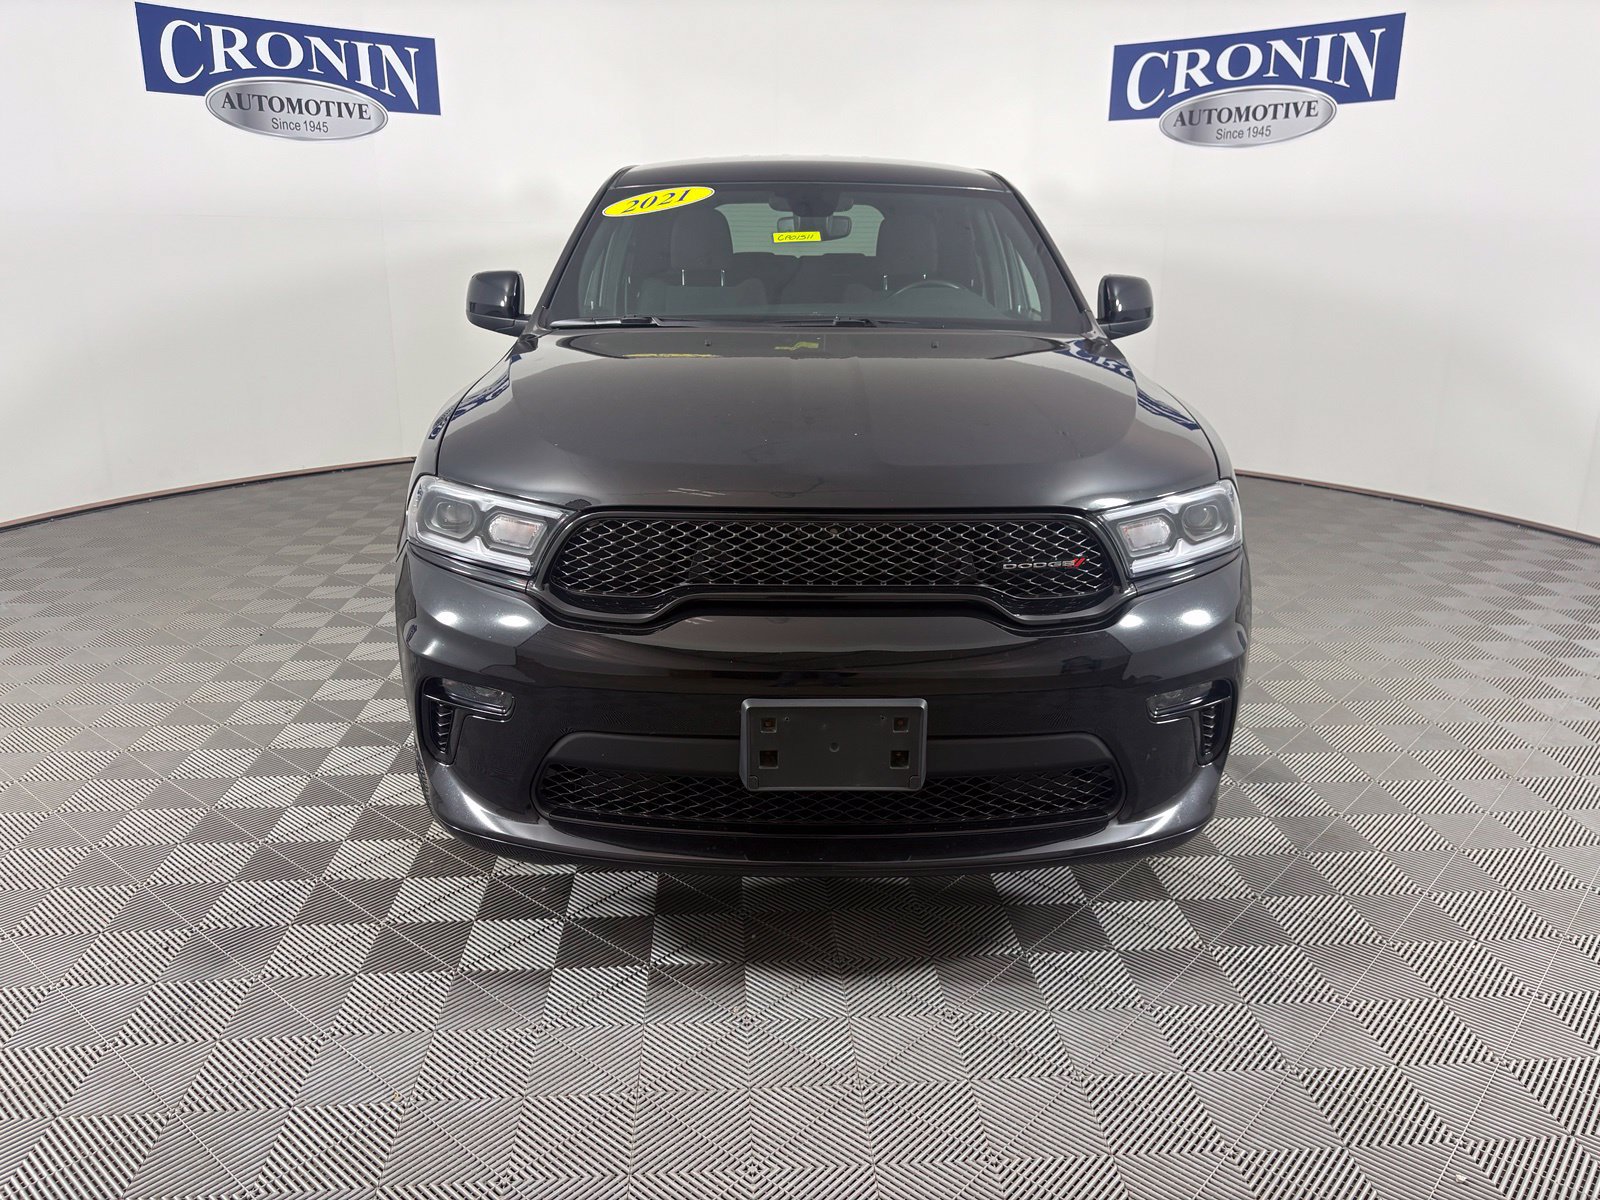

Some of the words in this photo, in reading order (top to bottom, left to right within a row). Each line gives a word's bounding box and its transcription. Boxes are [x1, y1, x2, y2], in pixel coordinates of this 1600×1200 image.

[160, 19, 420, 110] CRONIN
[1126, 28, 1386, 111] CRONIN
[221, 92, 372, 121] AUTOMOTIVE
[1173, 100, 1319, 127] AUTOMOTIVE
[271, 118, 302, 131] Since
[304, 120, 329, 133] 1945
[1215, 128, 1245, 141] Since
[1247, 125, 1272, 138] 1945
[621, 189, 691, 214] 2021
[1003, 560, 1074, 569] DODGE
